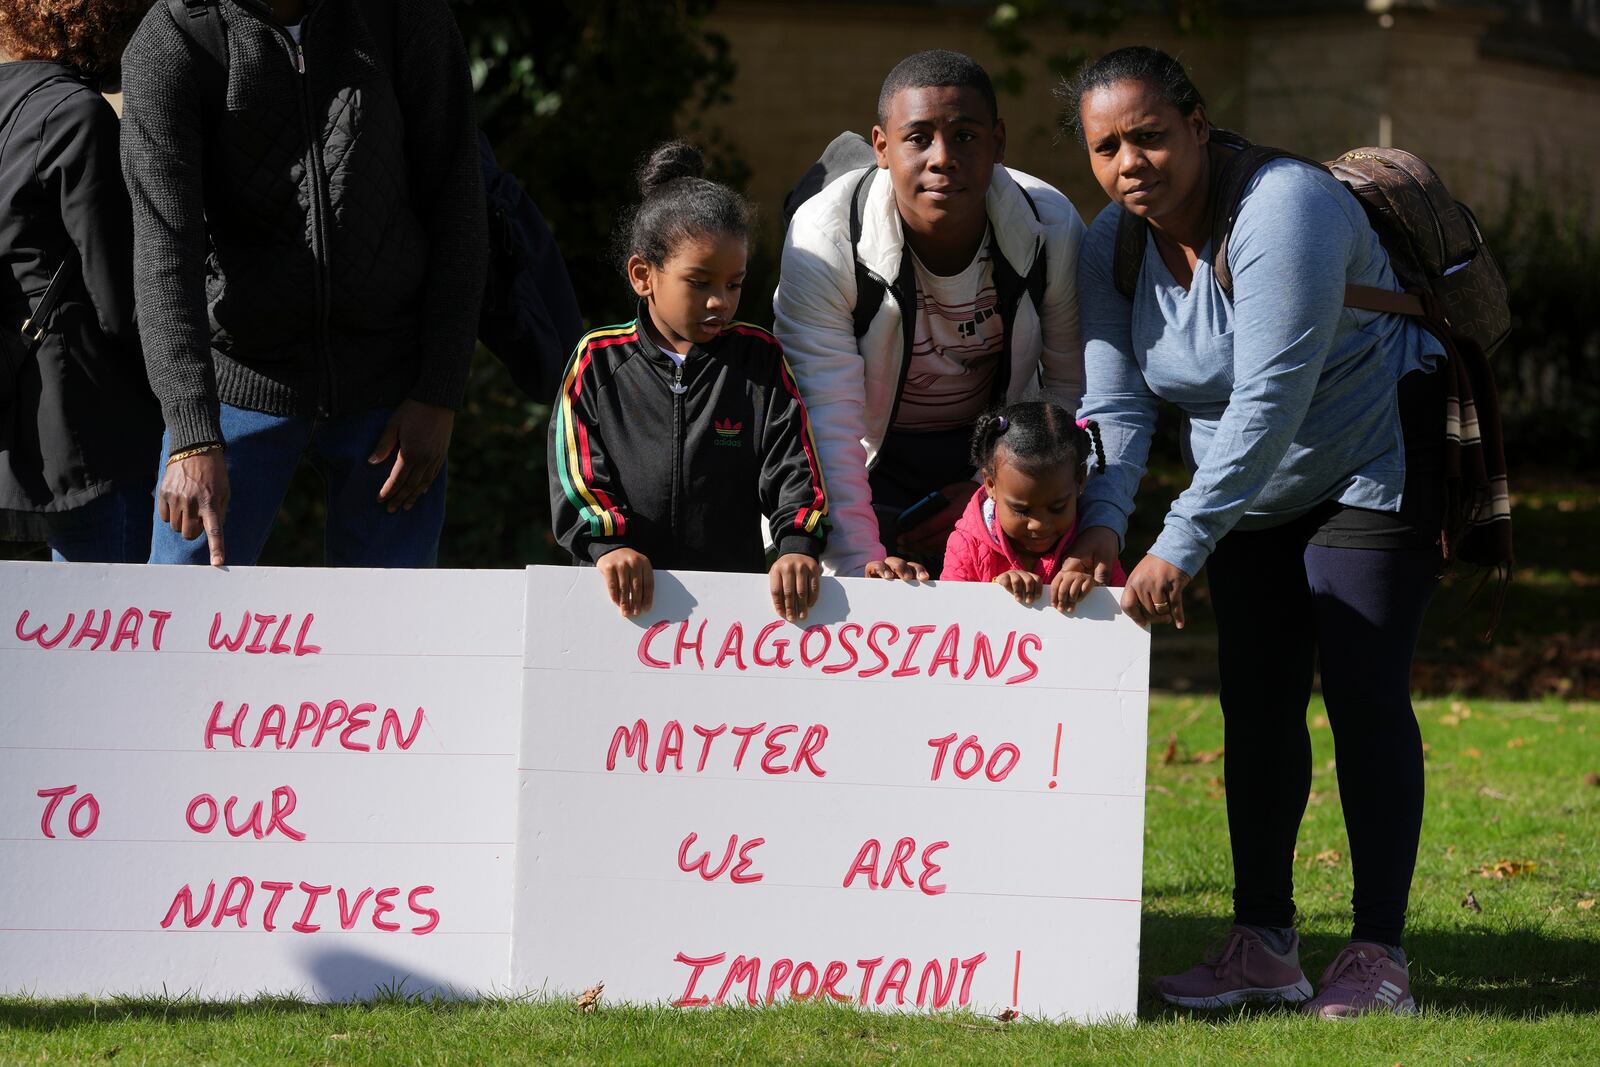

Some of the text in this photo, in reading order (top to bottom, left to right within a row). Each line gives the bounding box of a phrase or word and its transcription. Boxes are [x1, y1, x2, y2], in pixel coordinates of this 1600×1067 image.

[15, 608, 321, 656] WHAT WILL
[637, 619, 1043, 685] CHAGOSSIANS
[204, 699, 424, 752] HAPPEN
[606, 718, 828, 777] MATTER
[37, 784, 306, 842] TO OUR
[678, 832, 950, 895] WE ARE
[160, 875, 440, 936] NATIVES
